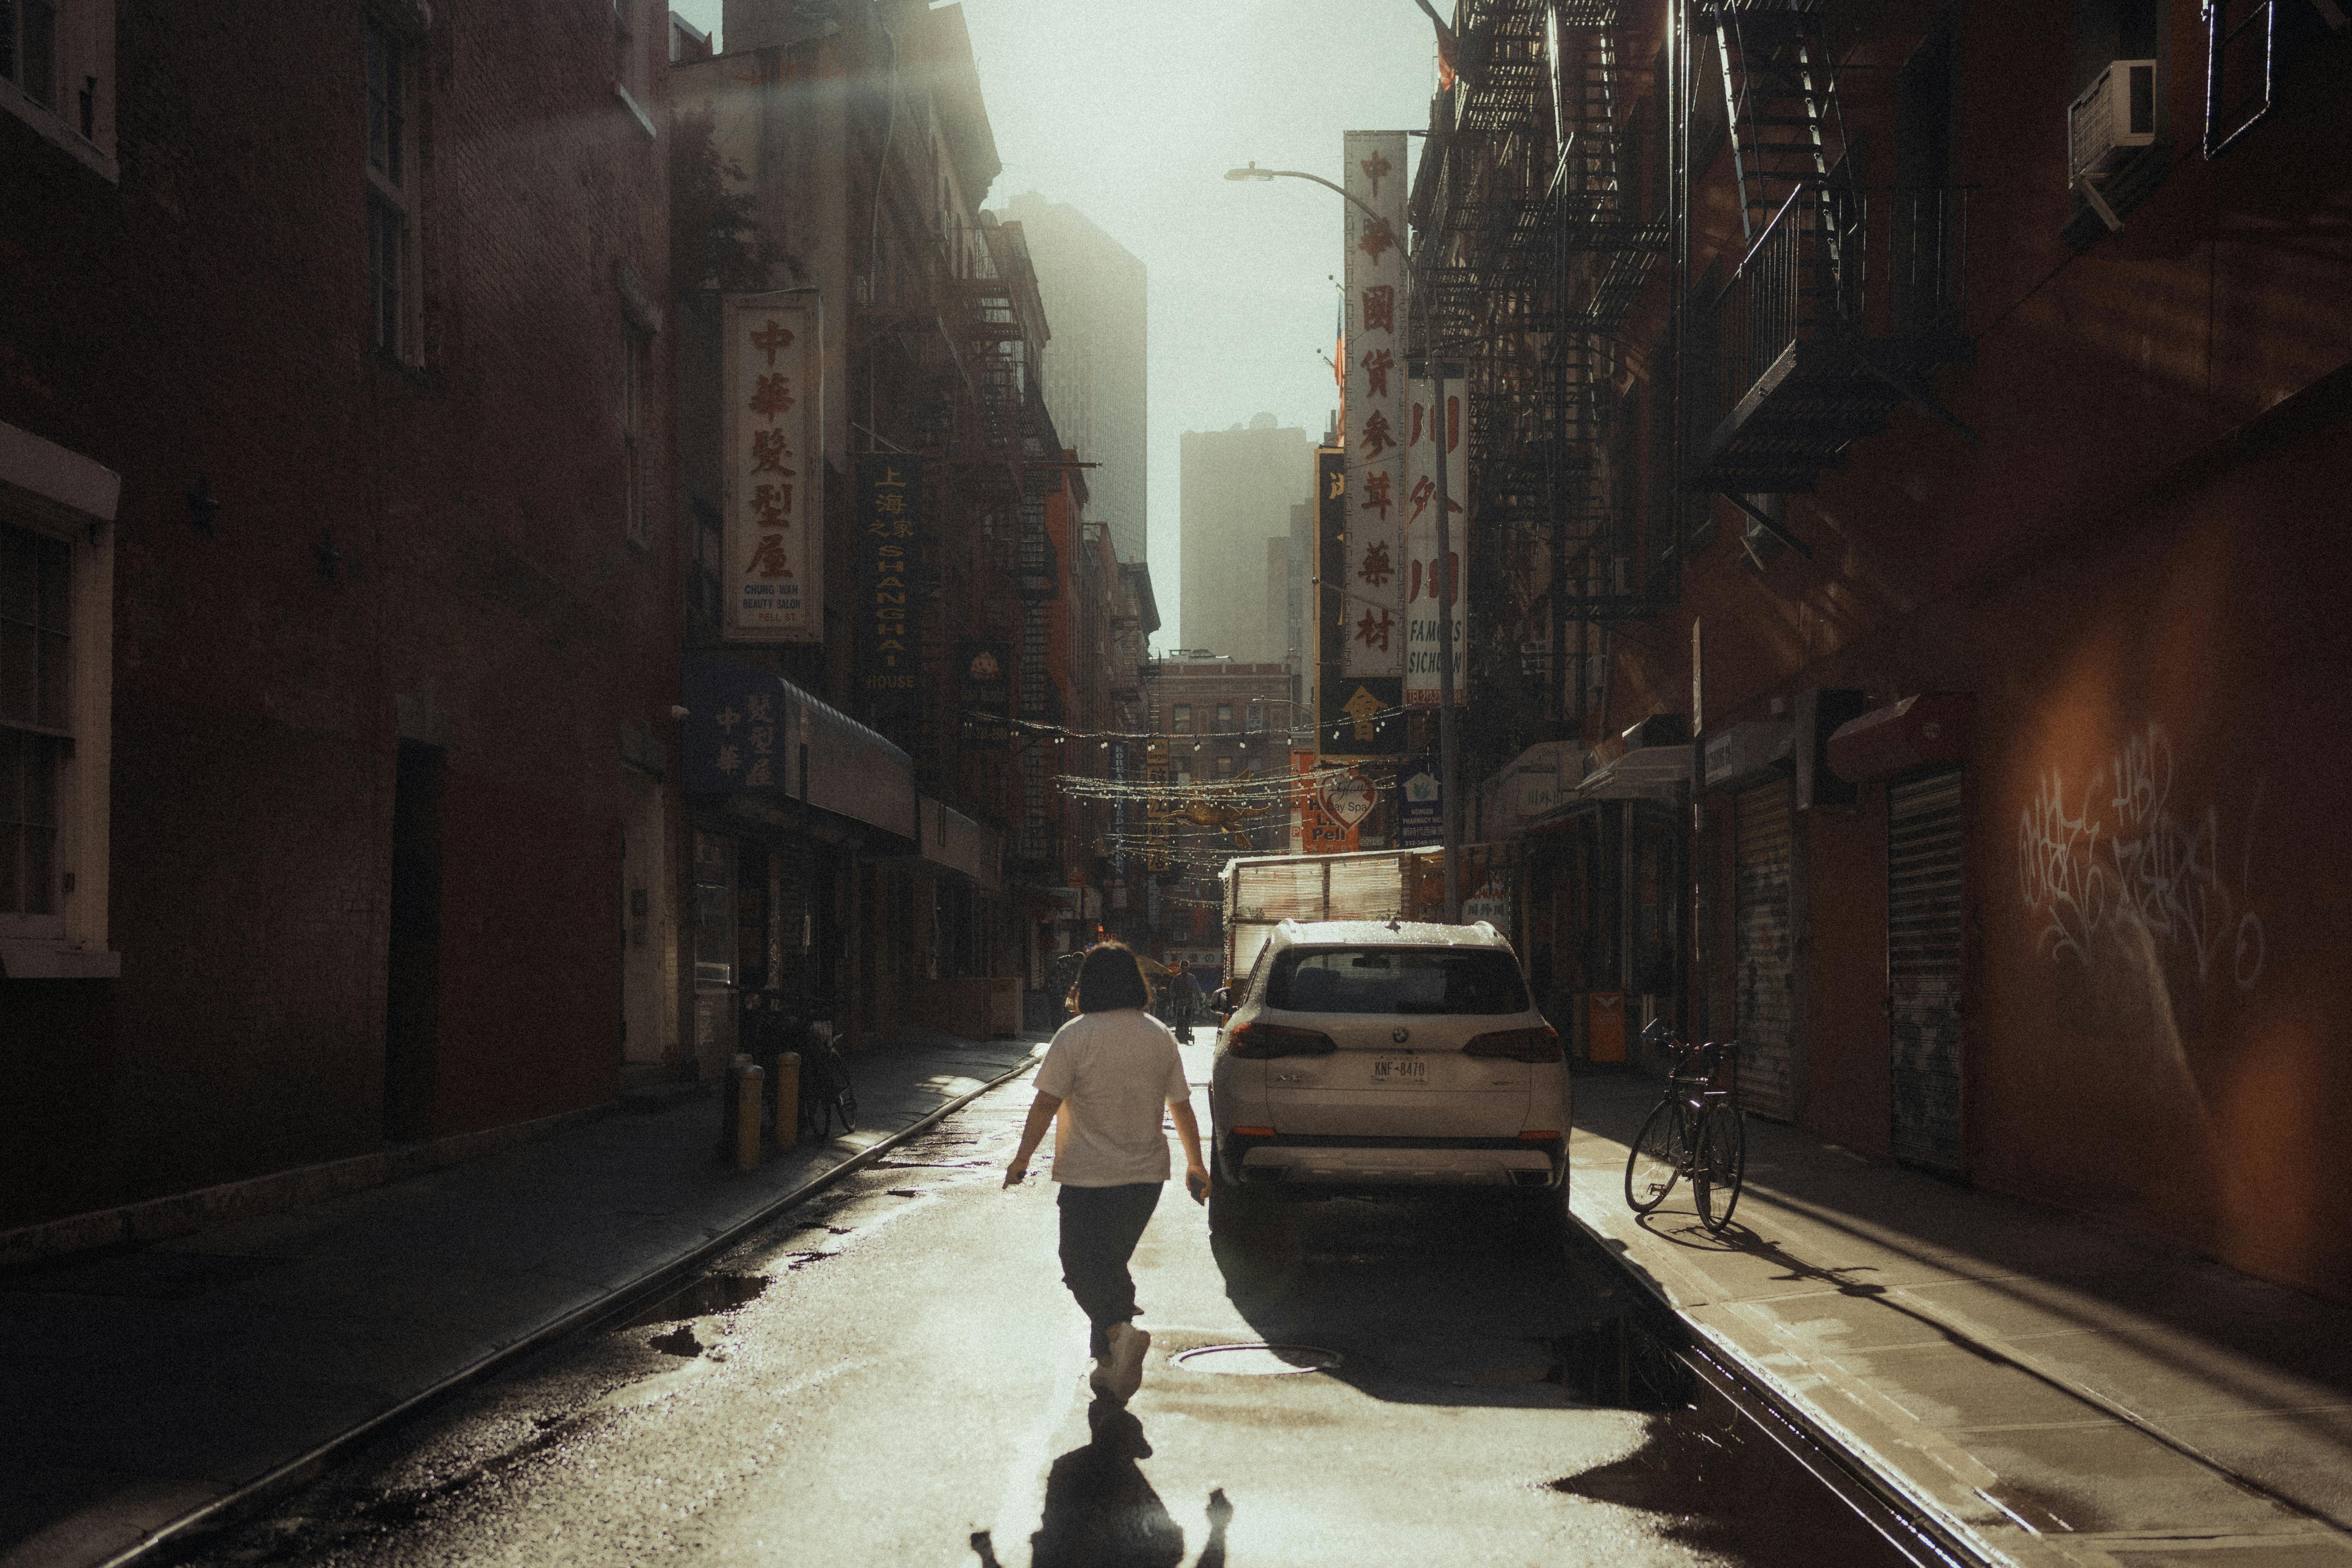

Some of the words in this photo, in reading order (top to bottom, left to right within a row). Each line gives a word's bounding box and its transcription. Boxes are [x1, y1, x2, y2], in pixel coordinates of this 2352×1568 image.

[746, 319, 795, 578] 中華髮型屋
[1409, 395, 1463, 607] 川外川
[745, 584, 774, 594] CHUNG
[779, 585, 798, 594] WAH
[743, 599, 772, 608] BEAUTY
[777, 599, 800, 609] SALON
[876, 545, 906, 666] SHANGHAI
[1410, 619, 1461, 642] FAMS
[1408, 651, 1461, 673] SICHN
[867, 675, 914, 689] HOUSE
[1327, 802, 1345, 813] Day
[1348, 802, 1367, 813] Spa
[1312, 828, 1346, 841] Pell
[1098, 933, 1118, 942] BAR
